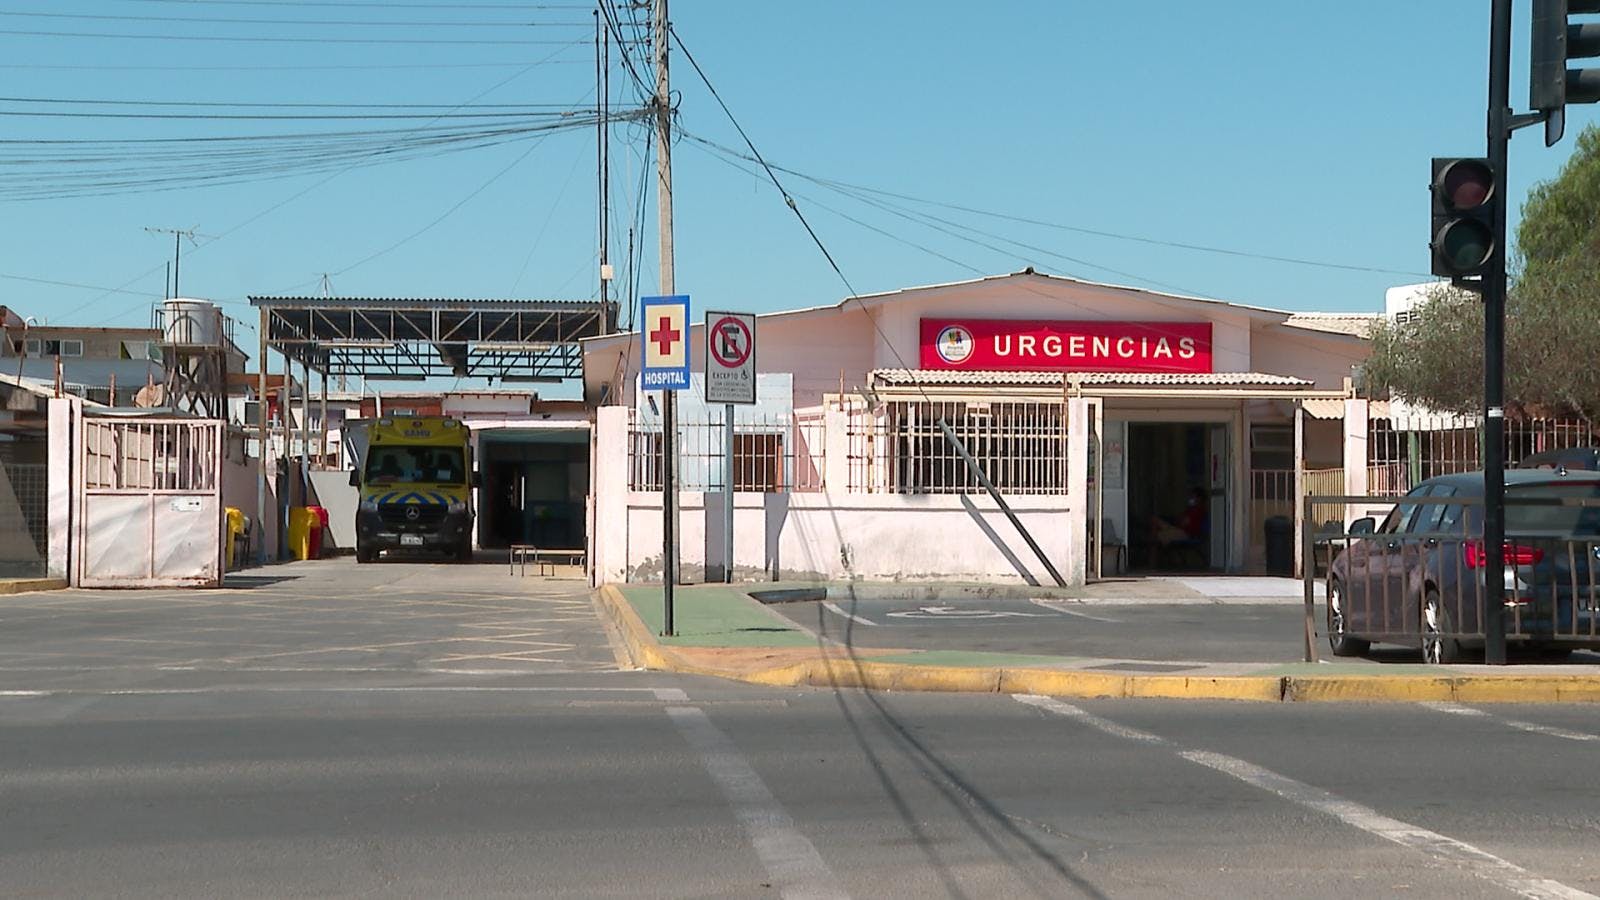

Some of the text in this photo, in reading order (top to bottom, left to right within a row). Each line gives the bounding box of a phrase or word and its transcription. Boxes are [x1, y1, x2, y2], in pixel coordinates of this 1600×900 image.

[994, 335, 1196, 359] URGENCIAS
[645, 371, 685, 385] HOSPITAL
[712, 371, 739, 380] EXCEPTO
